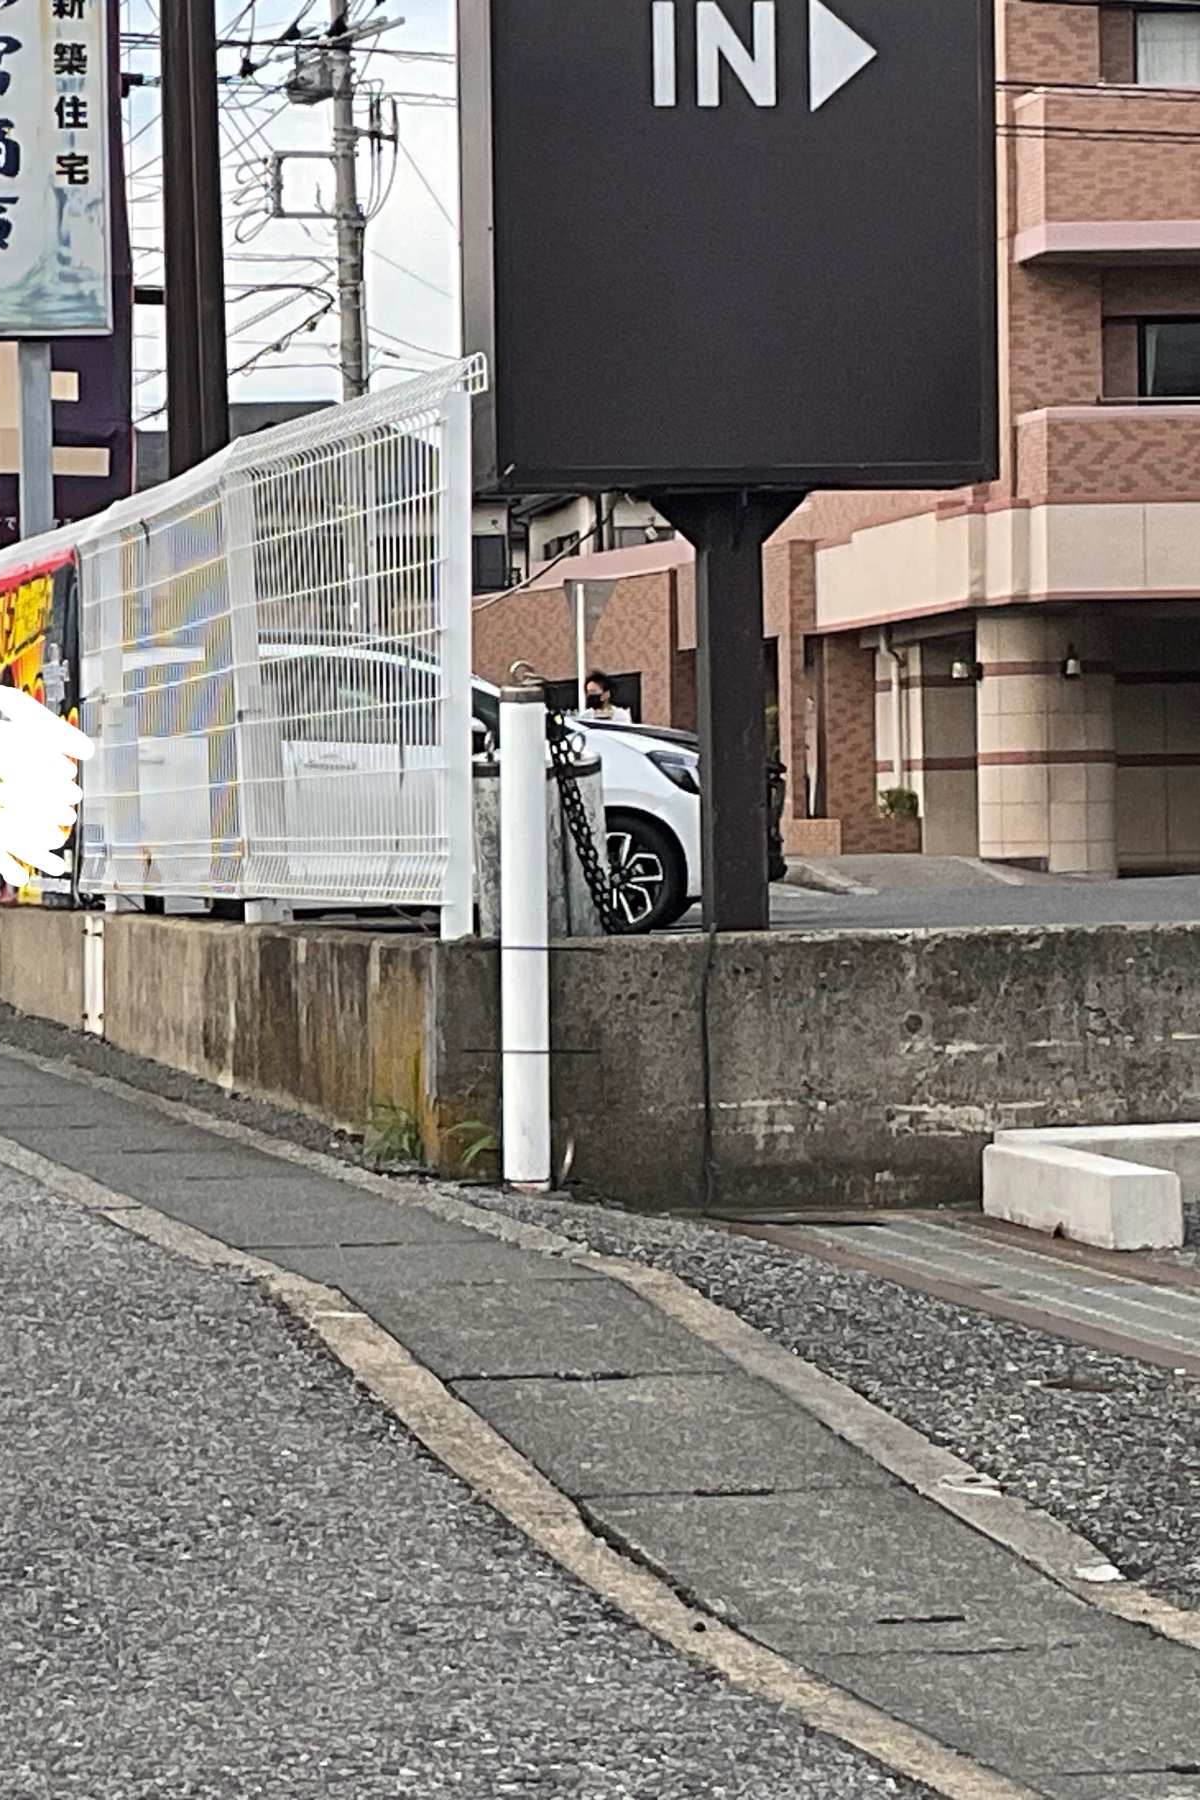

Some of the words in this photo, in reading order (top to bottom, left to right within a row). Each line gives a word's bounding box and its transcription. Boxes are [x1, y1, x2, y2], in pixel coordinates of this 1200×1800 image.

[52, 0, 90, 186] 新築住宅
[652, 1, 777, 107] IN
